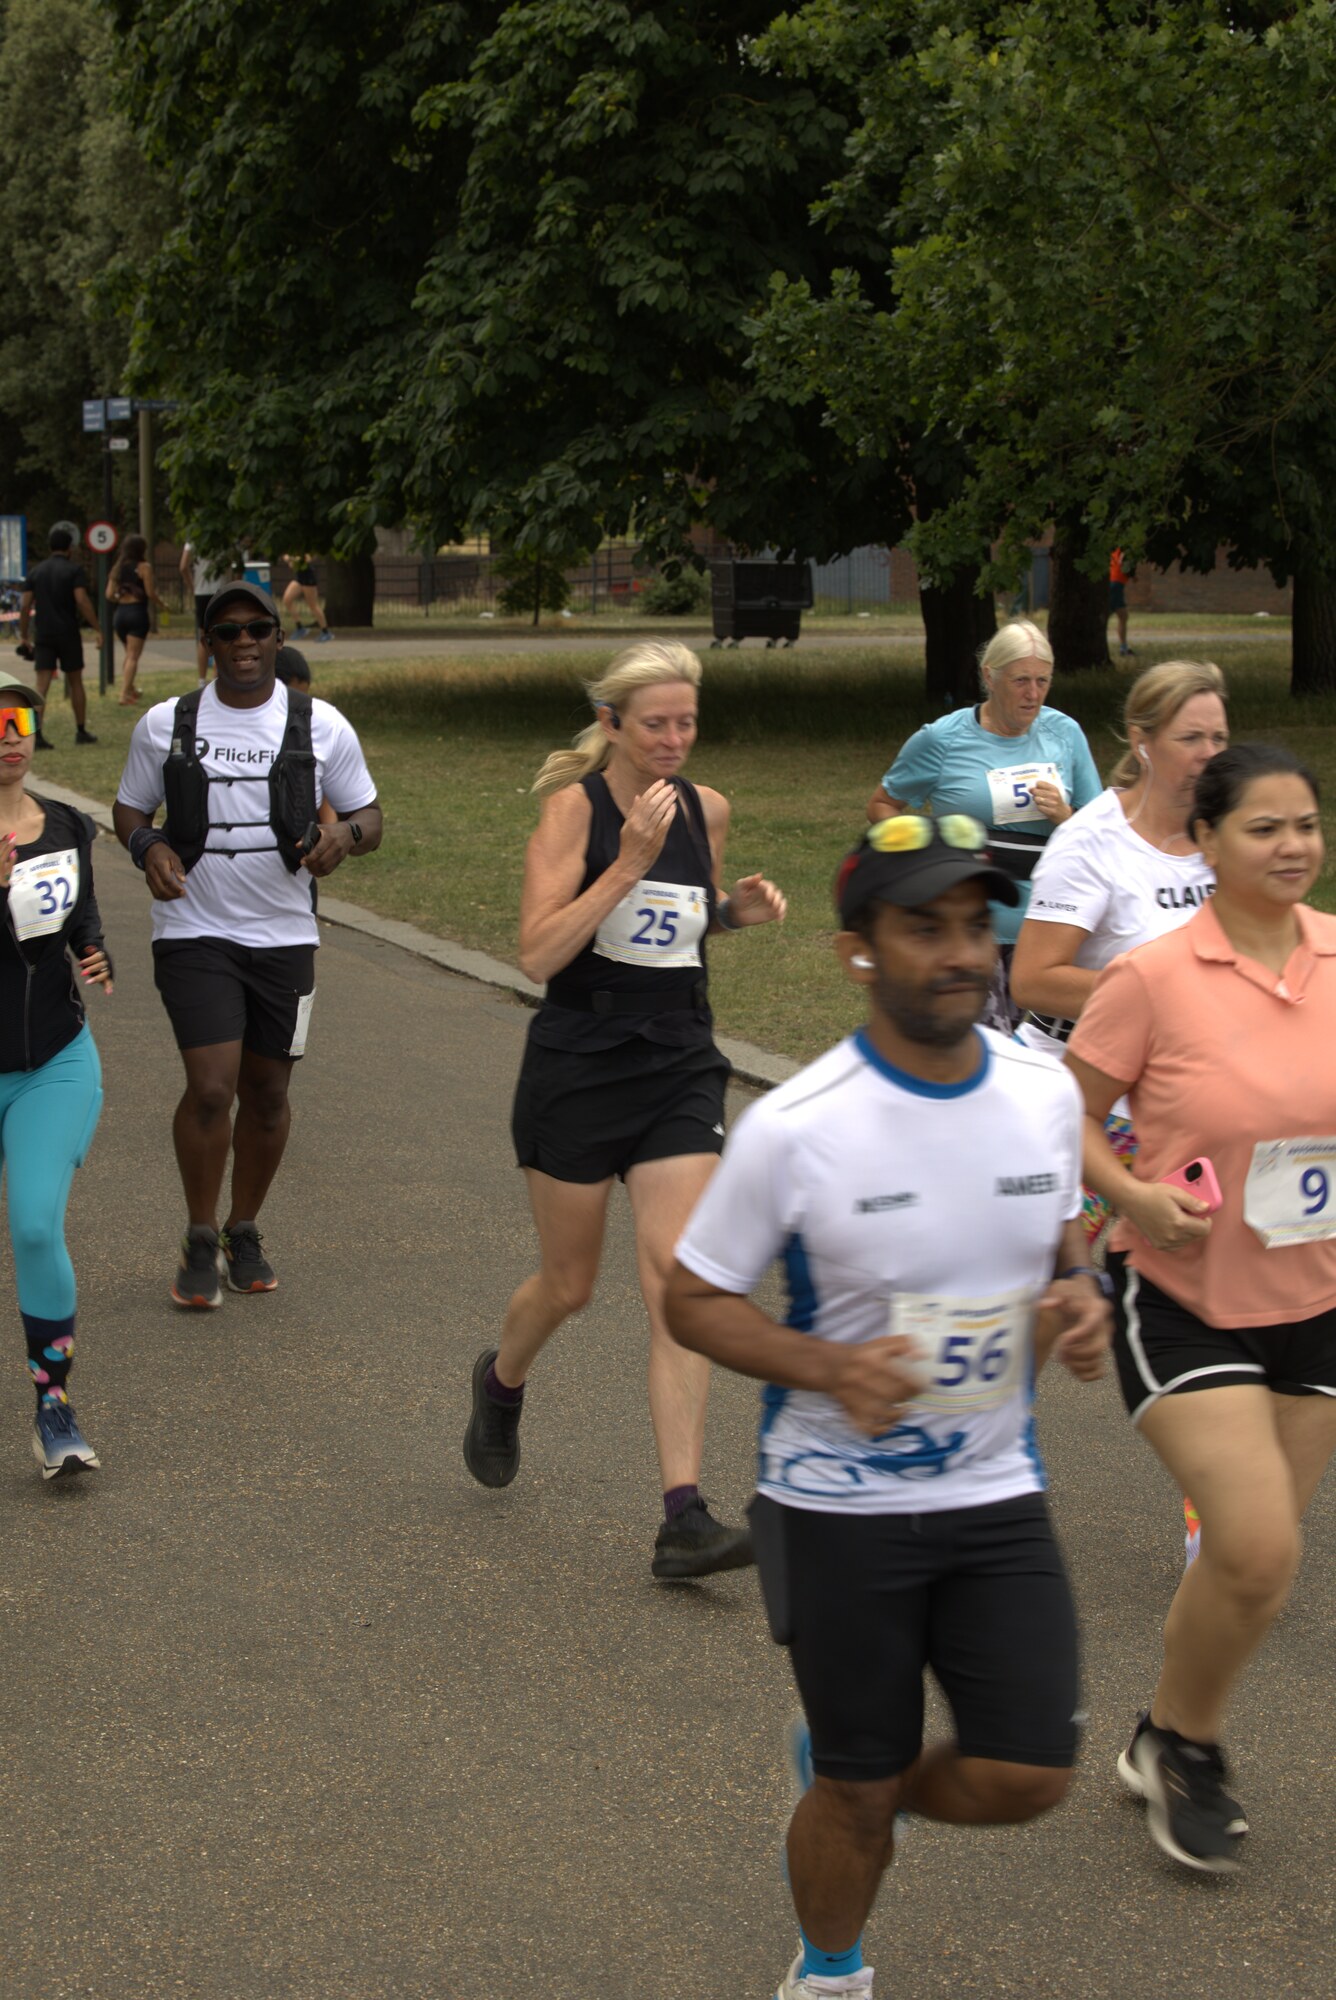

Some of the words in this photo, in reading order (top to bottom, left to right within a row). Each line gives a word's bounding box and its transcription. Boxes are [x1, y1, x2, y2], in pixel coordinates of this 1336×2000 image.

[98, 531, 106, 544] 5
[214, 748, 276, 764] FlickFi
[1013, 784, 1031, 808] 5
[34, 877, 74, 915] 32
[631, 908, 680, 946] 25
[1300, 1167, 1329, 1215] 9
[936, 1328, 1010, 1387] 56
